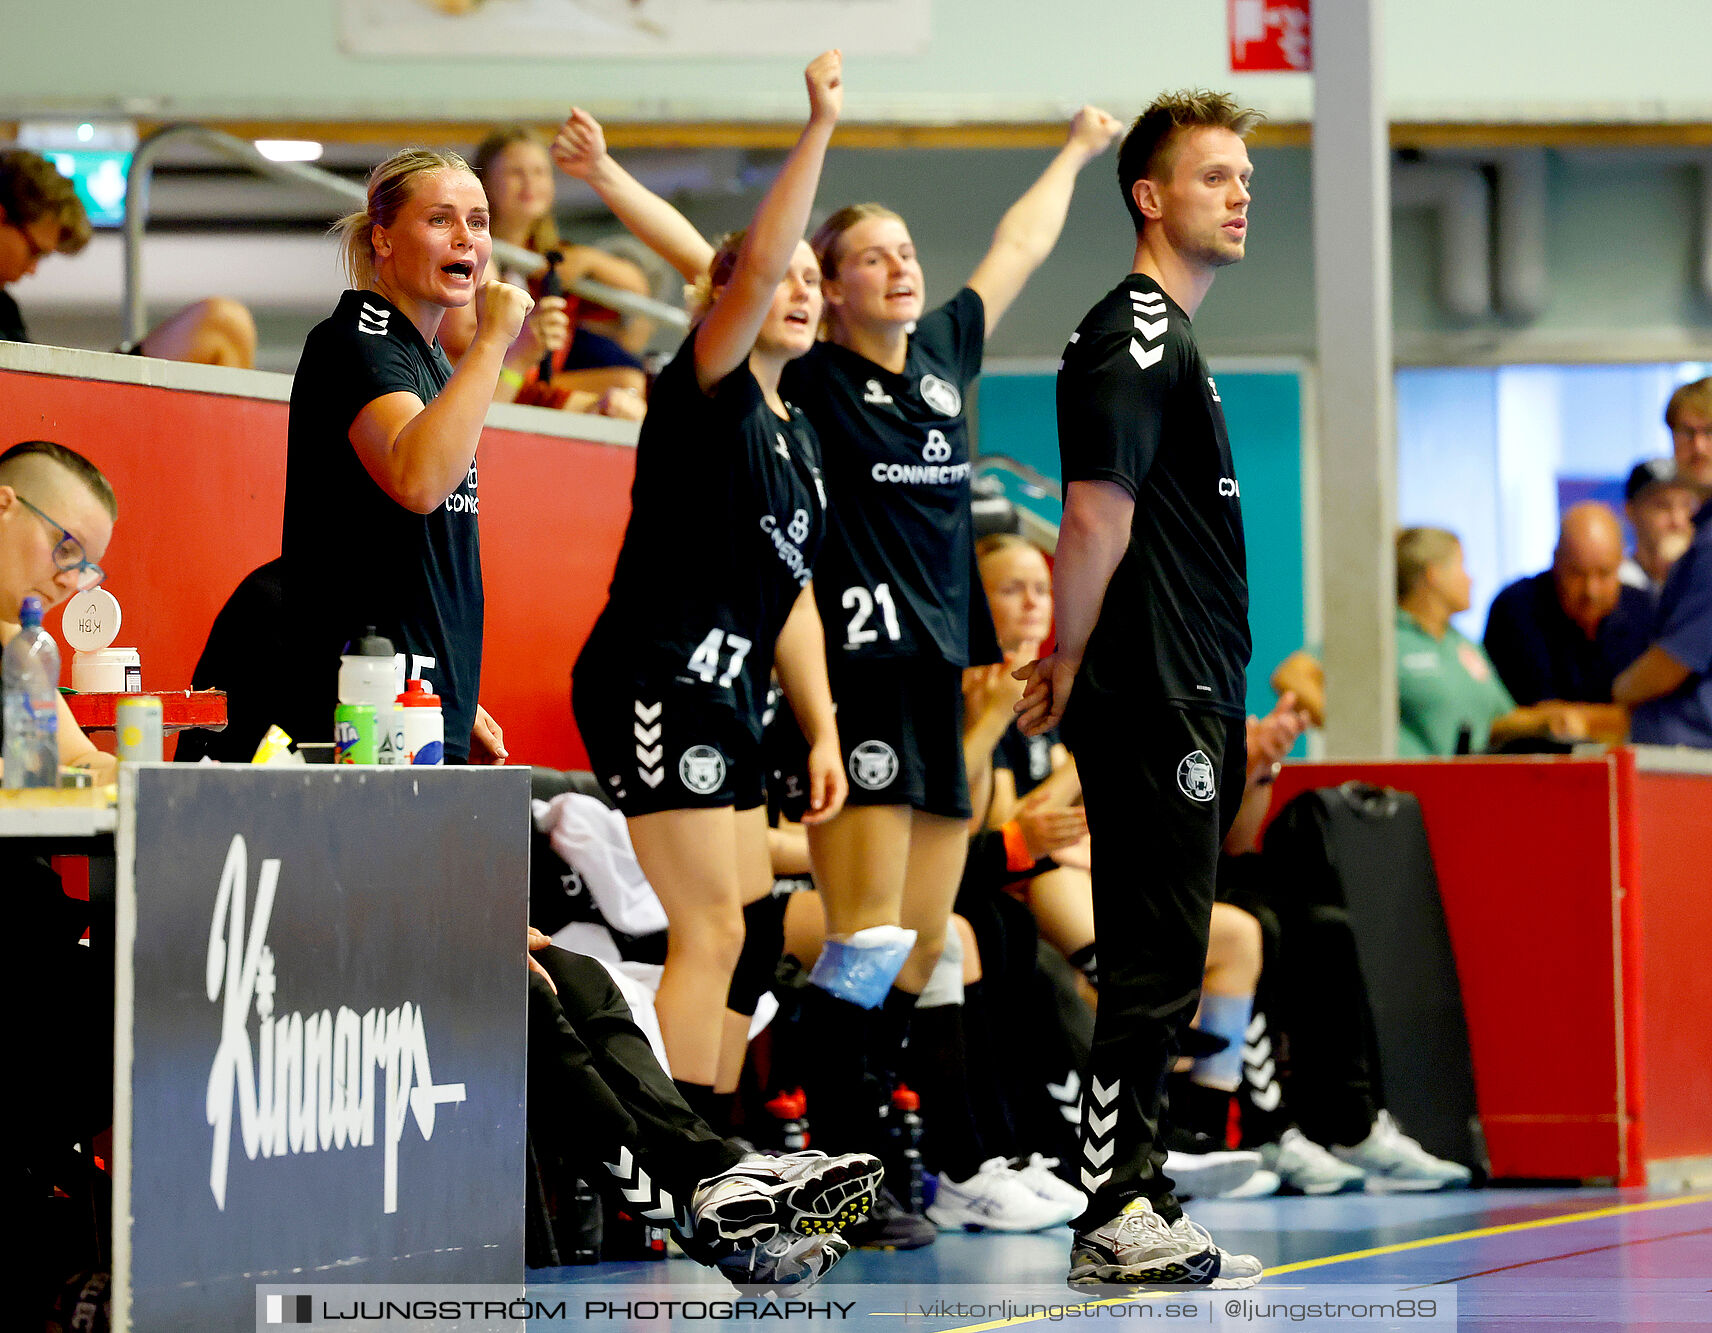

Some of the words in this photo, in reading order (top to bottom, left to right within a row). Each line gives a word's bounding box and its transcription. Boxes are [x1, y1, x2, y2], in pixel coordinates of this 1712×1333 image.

[842, 582, 901, 644] 21
[687, 627, 752, 688] 47
[206, 833, 467, 1213] Kinnarps
